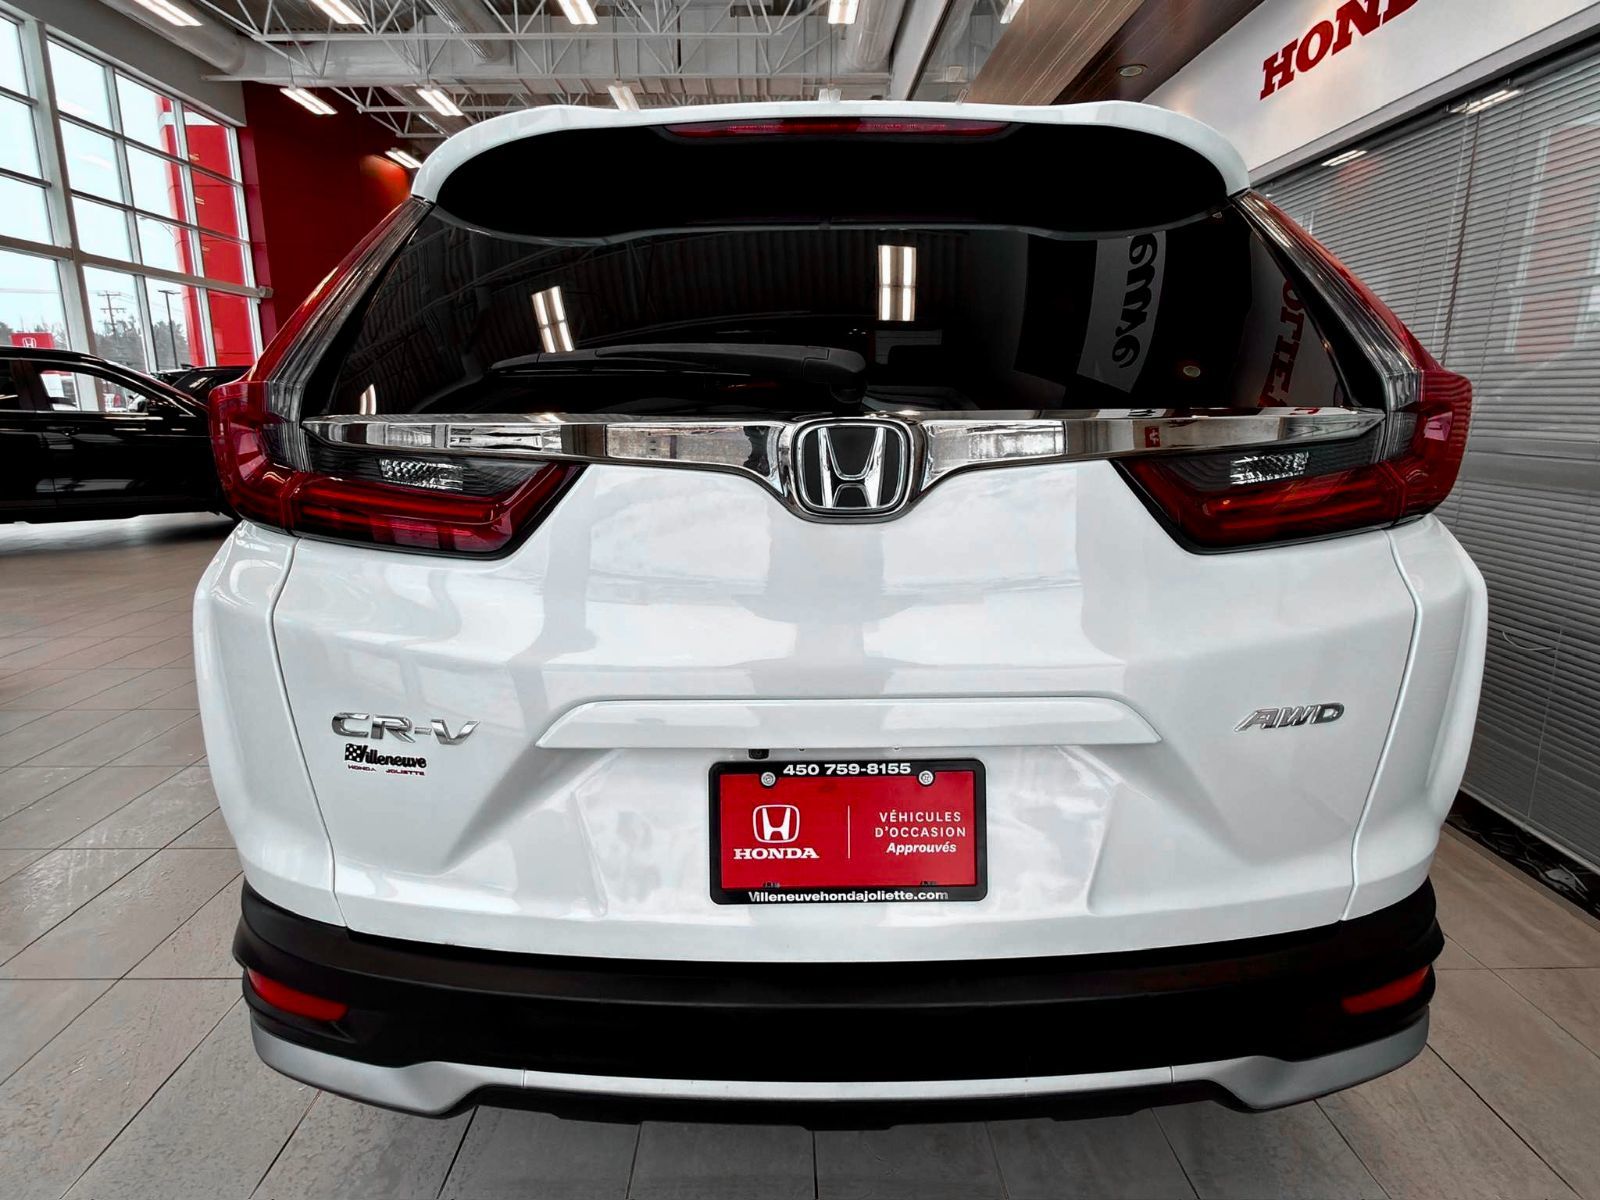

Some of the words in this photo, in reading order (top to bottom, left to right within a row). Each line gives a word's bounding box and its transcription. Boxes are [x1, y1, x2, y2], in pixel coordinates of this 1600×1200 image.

[1234, 702, 1345, 732] AWD
[331, 712, 480, 746] CR-V
[783, 763, 820, 776] 450
[824, 762, 911, 776] 759-8155
[879, 809, 961, 823] VÉHICULES
[733, 847, 820, 860] HONDA
[886, 841, 957, 855] Approuvés
[748, 890, 949, 903] Villeneuvehondajoliette.com
